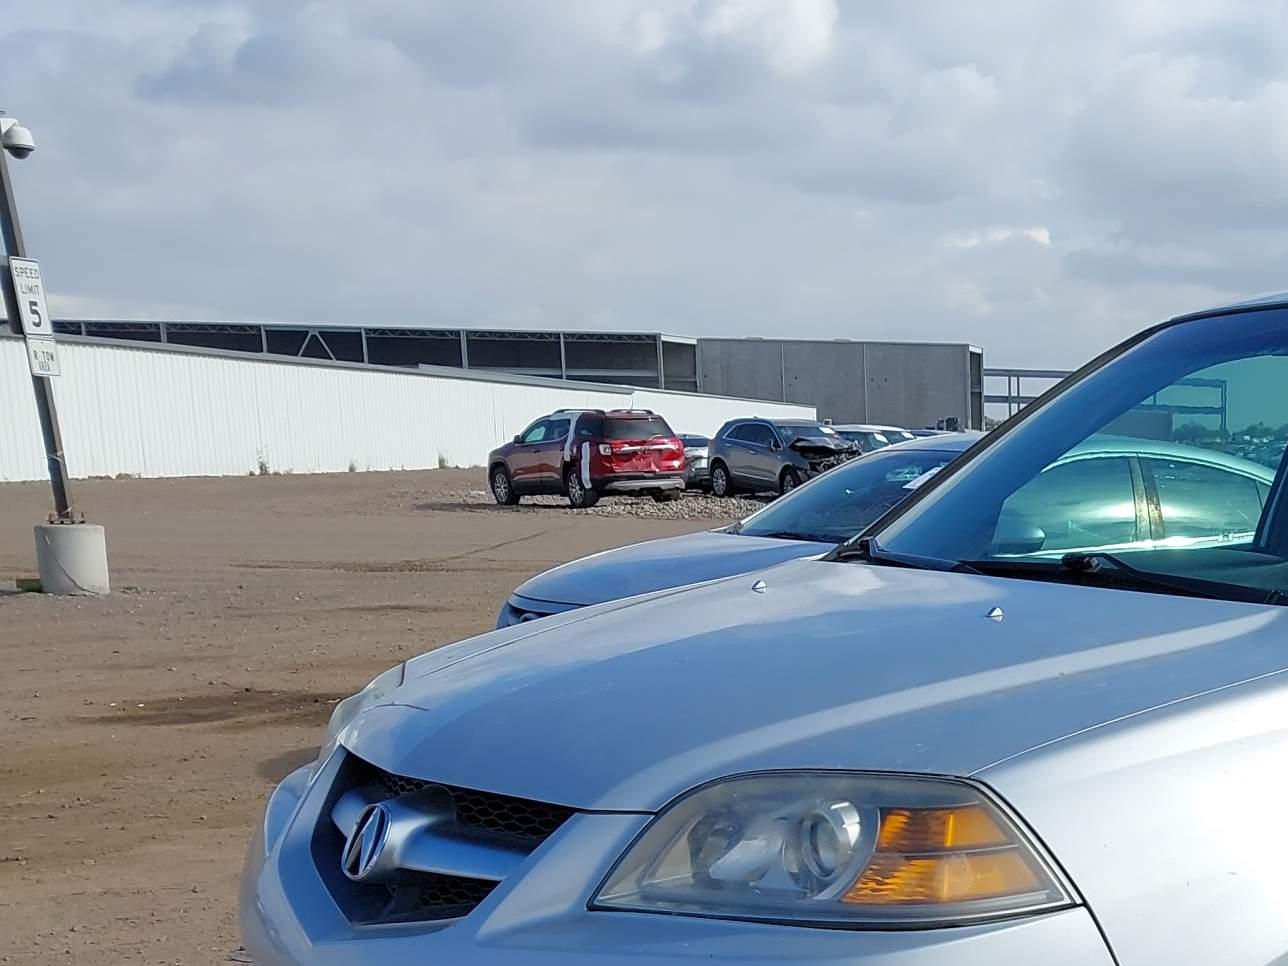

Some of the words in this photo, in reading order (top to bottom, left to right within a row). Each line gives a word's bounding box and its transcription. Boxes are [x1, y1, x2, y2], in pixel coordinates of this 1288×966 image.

[14, 266, 40, 279] SPEED
[20, 284, 39, 296] LIMIT
[29, 301, 42, 328] 5
